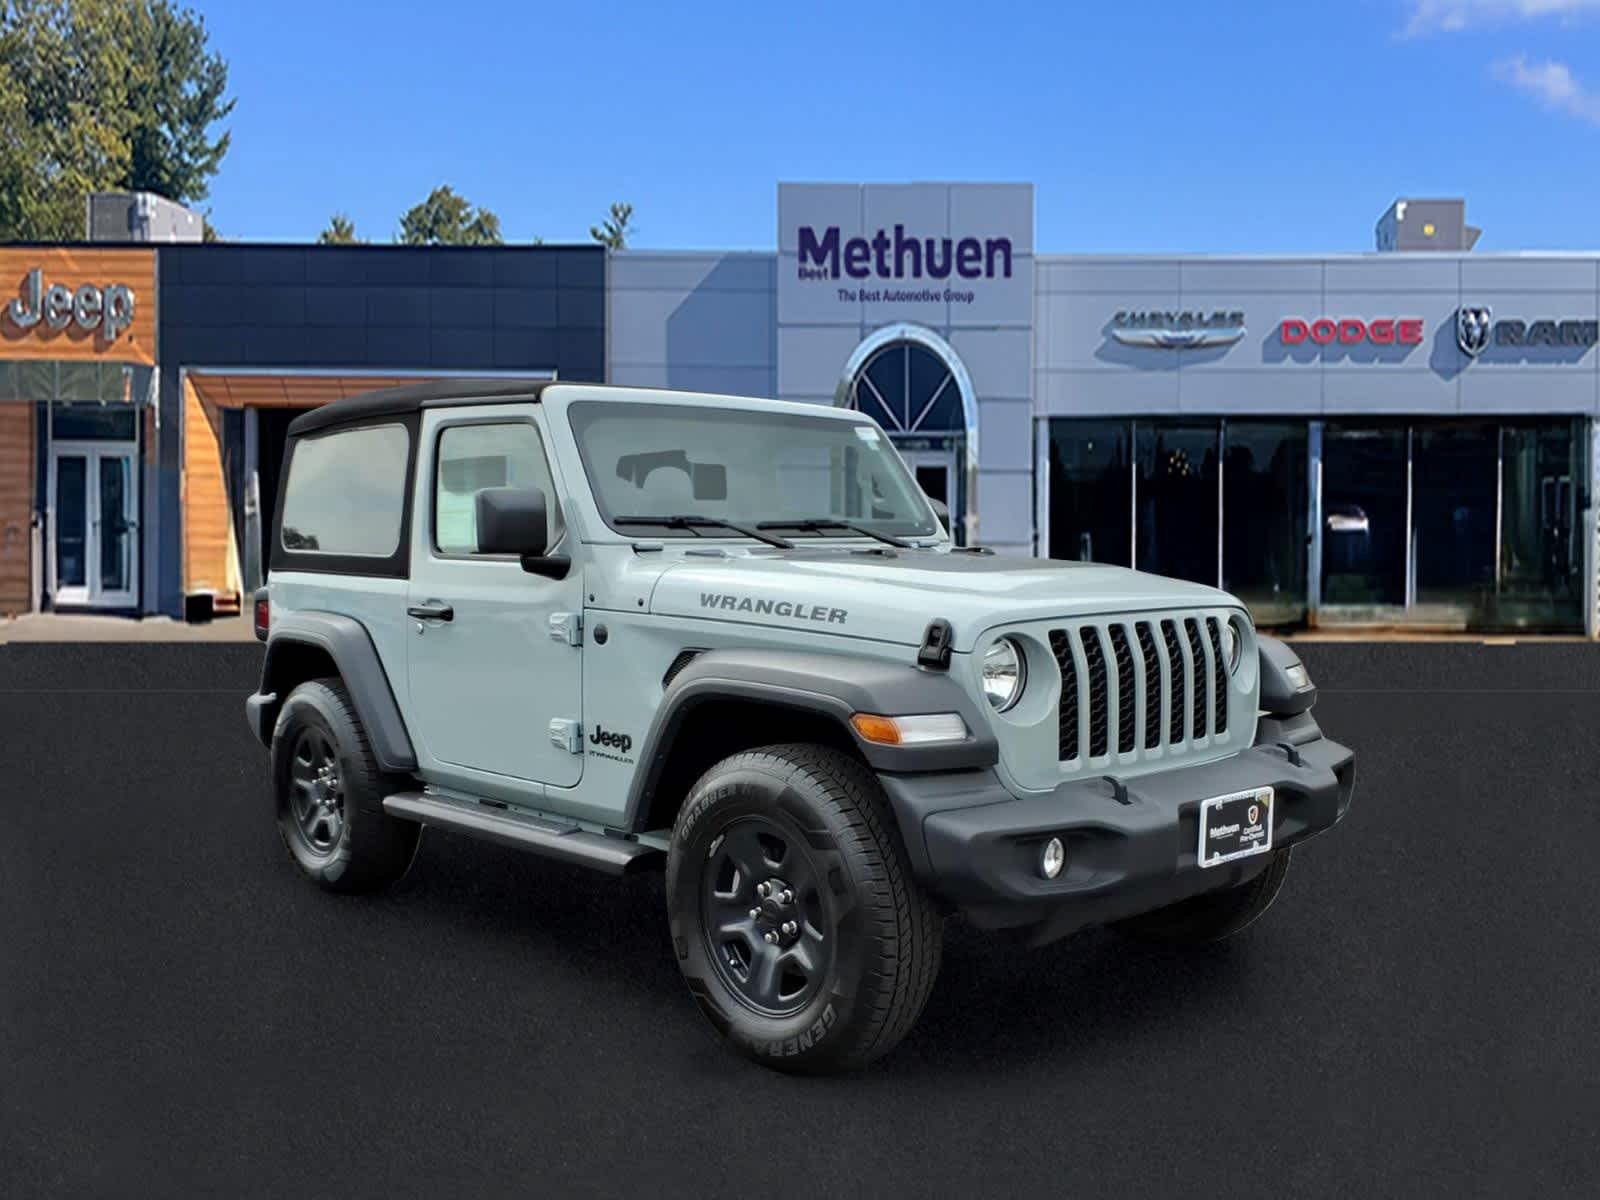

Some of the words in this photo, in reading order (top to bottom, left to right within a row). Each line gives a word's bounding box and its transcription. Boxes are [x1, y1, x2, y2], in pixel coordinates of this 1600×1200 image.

[798, 224, 1012, 279] Methuen
[798, 266, 828, 281] Best
[9, 268, 135, 341] Jeep
[838, 288, 857, 302] The
[859, 288, 880, 302] Best
[882, 288, 941, 302] Automotive
[943, 288, 975, 304] Group
[1113, 311, 1245, 328] CHRYSLER
[1281, 319, 1424, 345] DODGE
[1495, 319, 1599, 348] RAM
[700, 592, 849, 624] WRANGLER
[590, 724, 632, 753] Jeep
